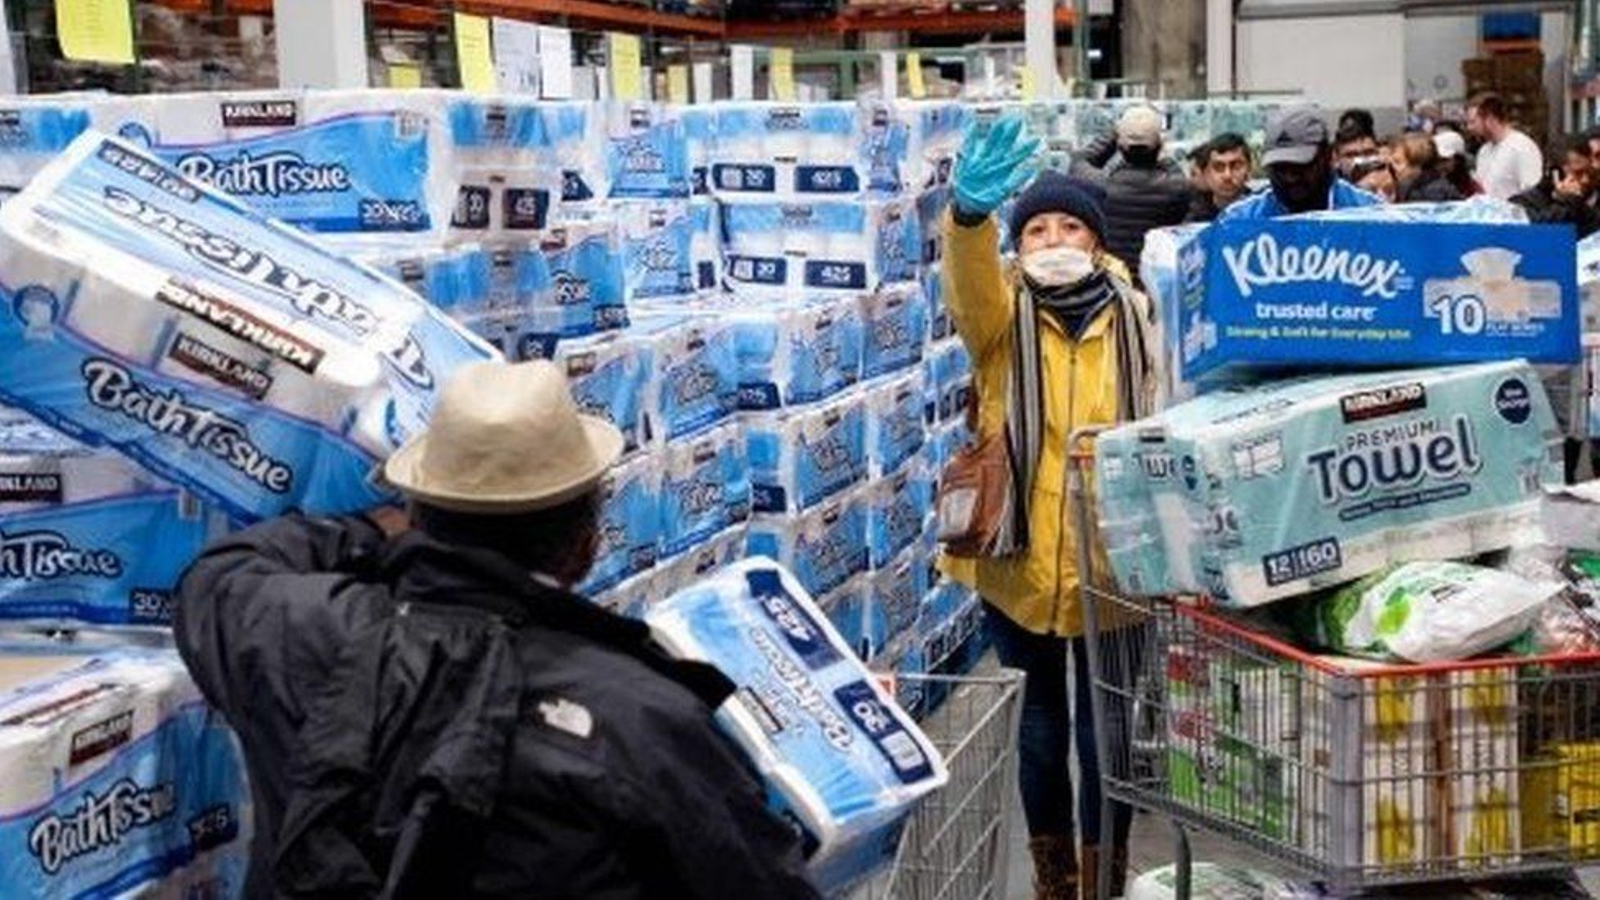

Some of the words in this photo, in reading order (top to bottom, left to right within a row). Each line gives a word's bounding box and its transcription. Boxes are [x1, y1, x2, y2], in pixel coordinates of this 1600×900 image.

[1222, 233, 1400, 298] Kleenex
[1256, 302, 1328, 319] trusted
[1331, 306, 1374, 321] care
[1430, 296, 1484, 335] 10
[178, 339, 268, 389] KIRKLAND
[1343, 385, 1422, 412] KIRKLAND
[84, 360, 187, 434] Bath
[180, 403, 291, 491] Tissue
[1345, 420, 1435, 449] PREMIUM
[1308, 417, 1475, 500] Towel
[0, 477, 58, 490] KLAND
[1267, 554, 1292, 576] 12
[1298, 542, 1338, 567] 160
[763, 596, 811, 641] 425
[853, 701, 890, 733] 30
[31, 796, 110, 872] Bath
